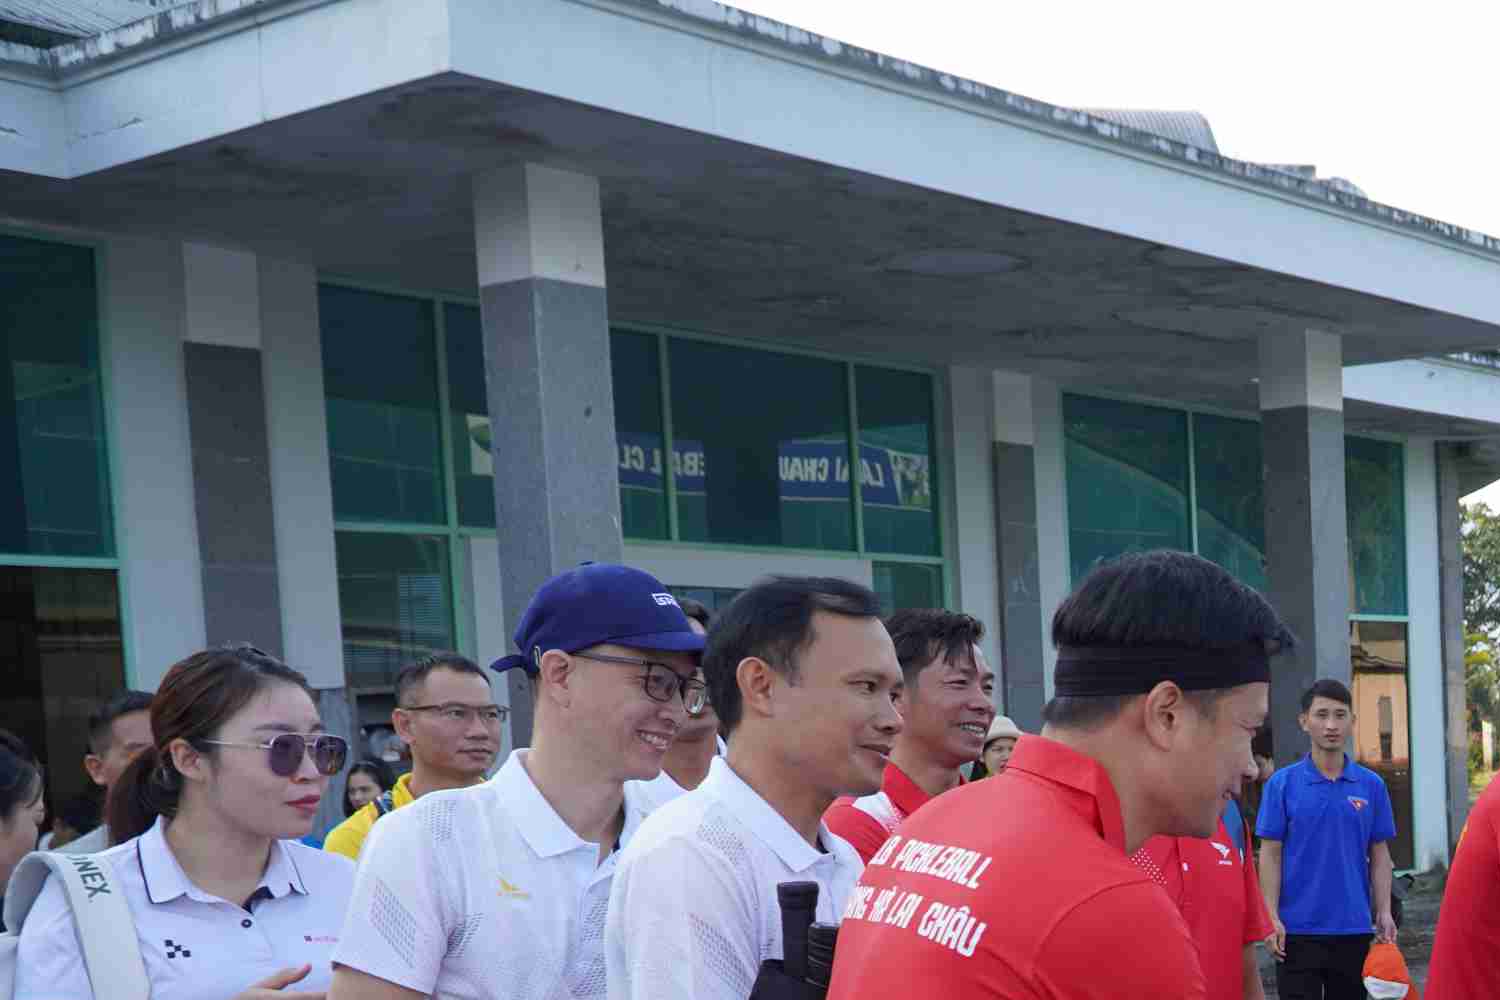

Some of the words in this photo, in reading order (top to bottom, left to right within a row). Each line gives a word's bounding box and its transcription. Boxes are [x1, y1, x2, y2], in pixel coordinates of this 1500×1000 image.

[66, 855, 112, 899] NEX
[868, 835, 902, 866] LB
[891, 839, 993, 890] PICKLEBALL
[884, 891, 924, 929] LAI
[917, 901, 987, 958] CHÂU
